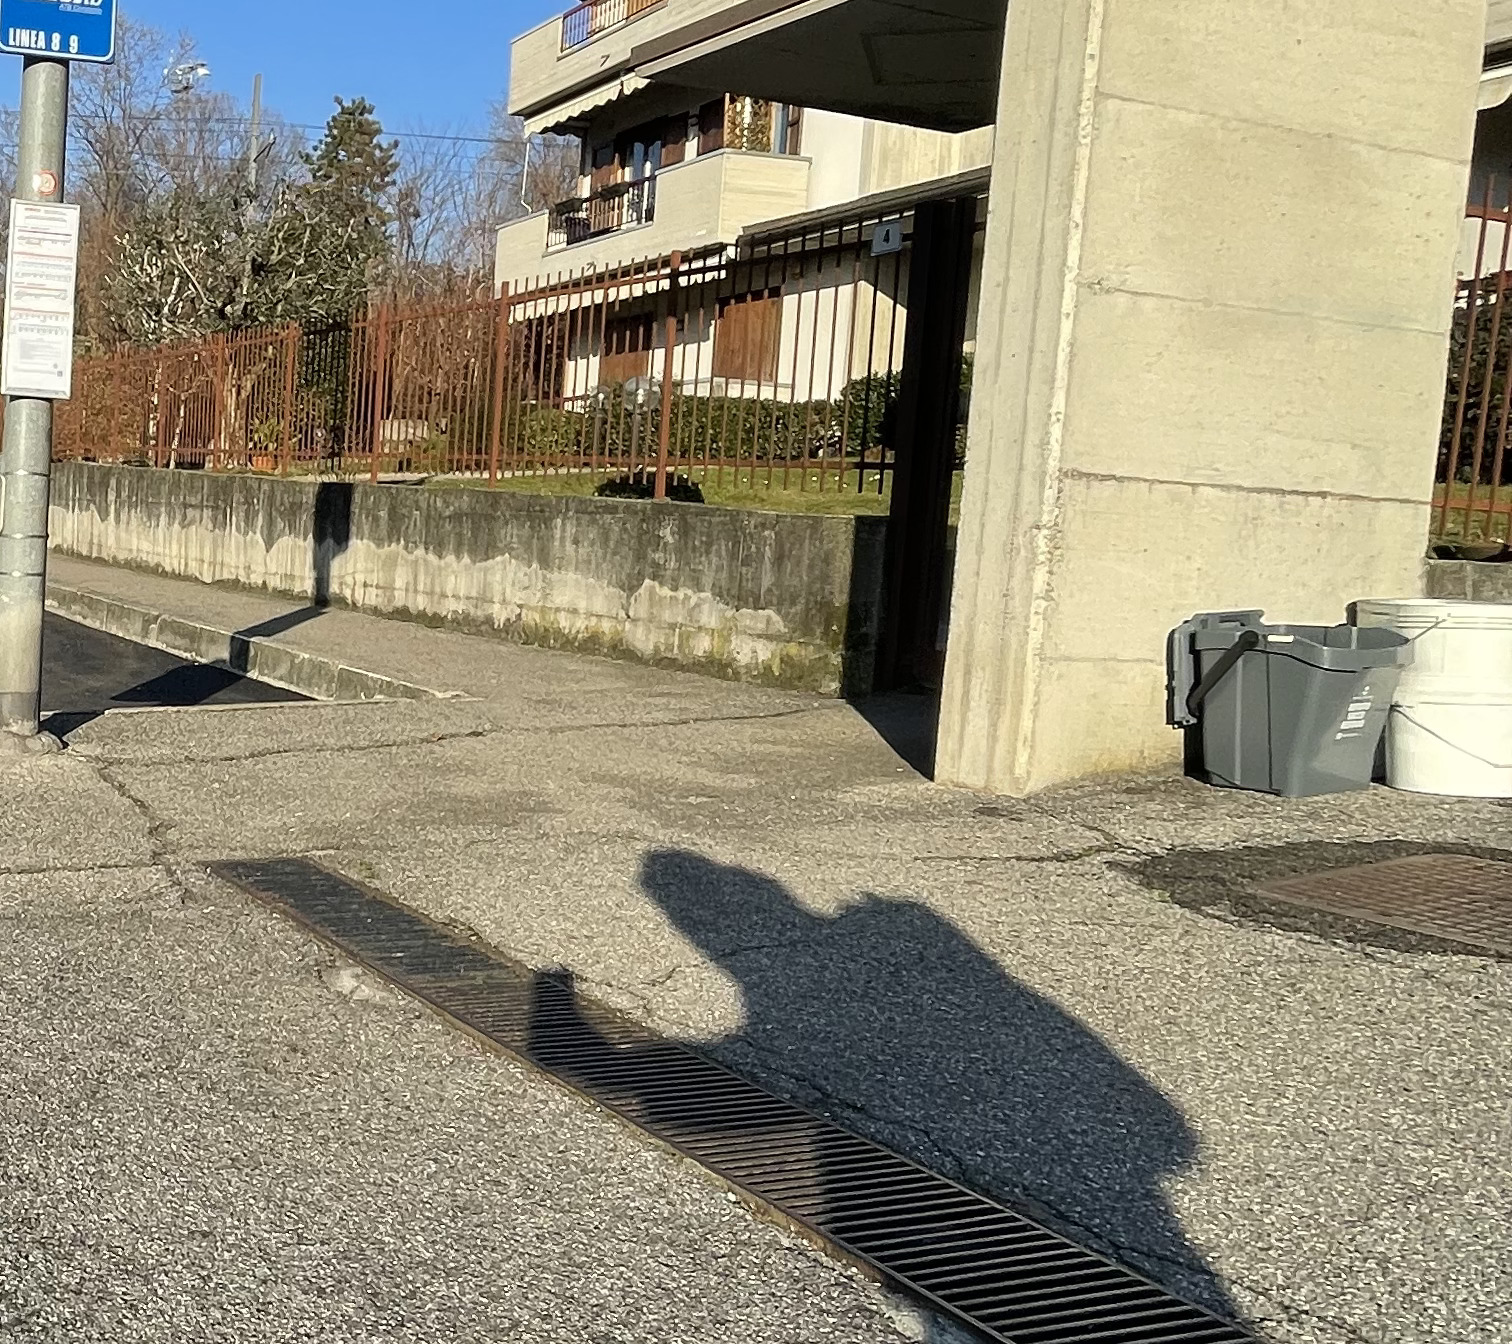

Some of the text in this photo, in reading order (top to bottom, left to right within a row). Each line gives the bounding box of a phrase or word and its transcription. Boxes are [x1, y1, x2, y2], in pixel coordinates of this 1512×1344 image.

[8, 28, 79, 54] LINEA 8 9
[882, 227, 891, 245] 4
